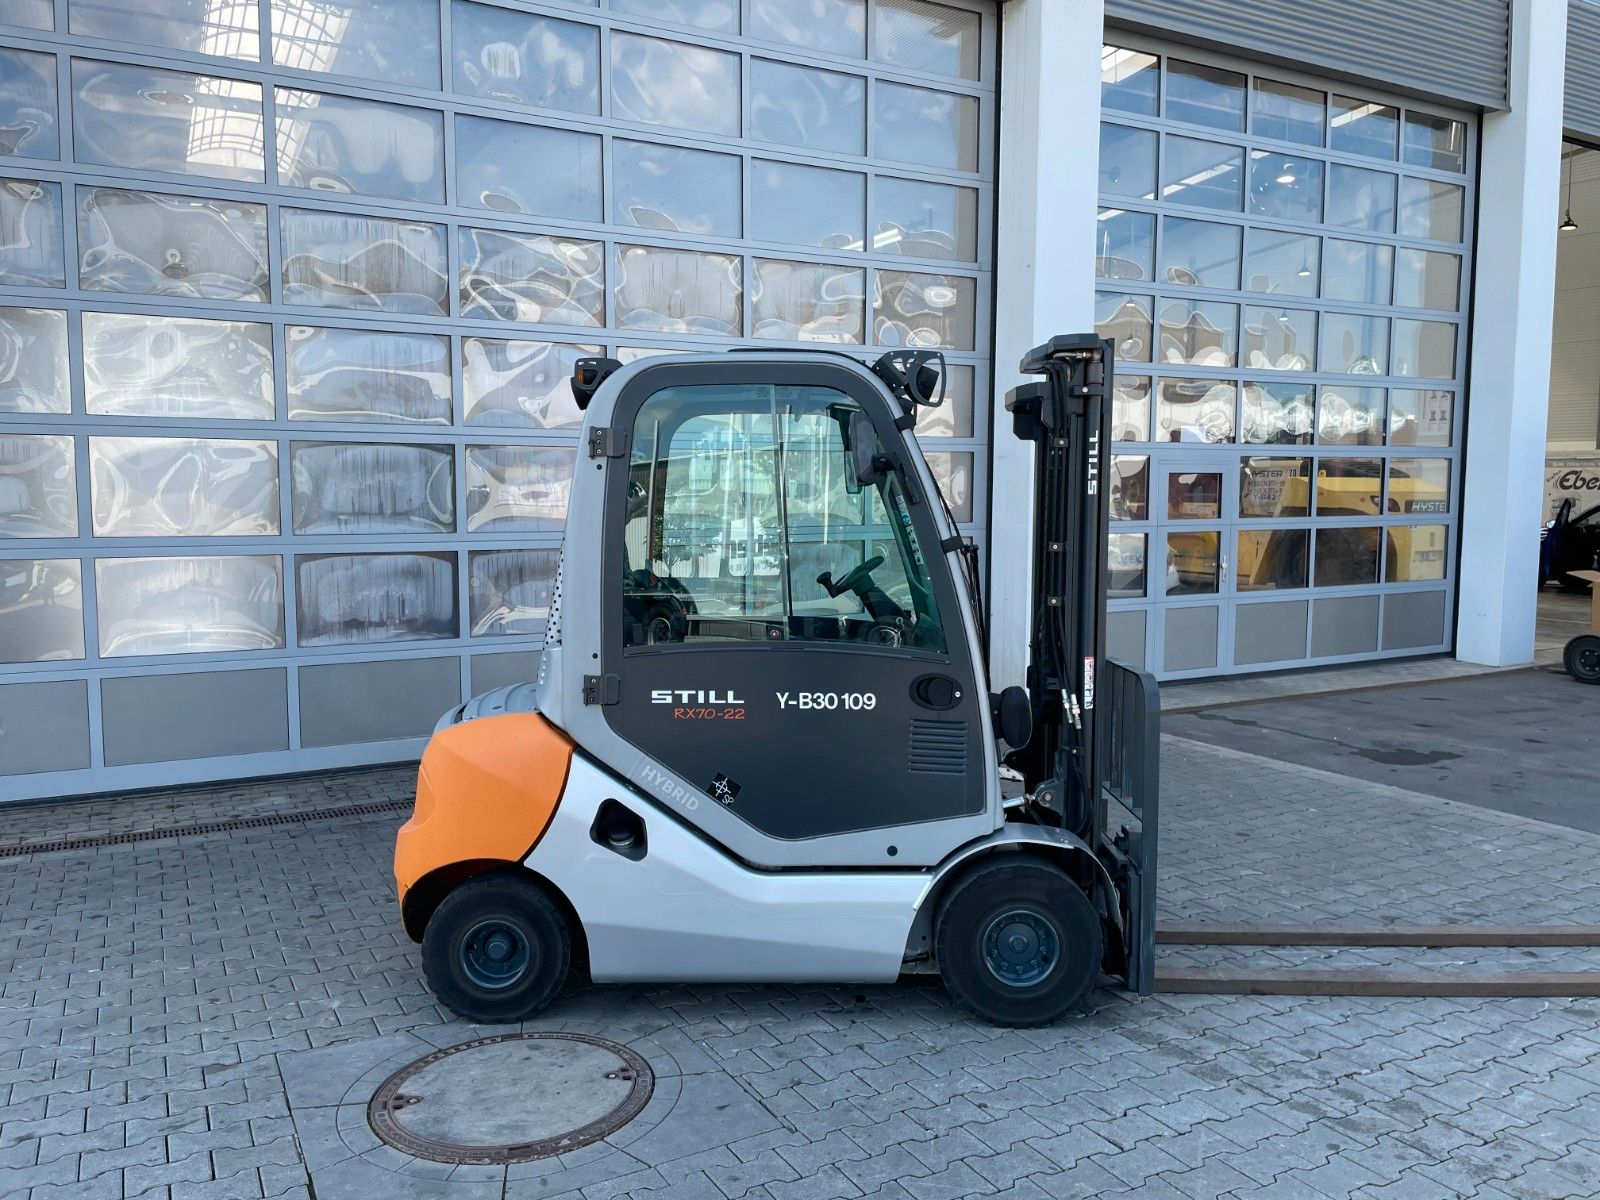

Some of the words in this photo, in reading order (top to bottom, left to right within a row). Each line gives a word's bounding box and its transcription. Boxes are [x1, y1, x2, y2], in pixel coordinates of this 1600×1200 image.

[1087, 430, 1098, 495] STILL
[651, 690, 745, 704] STILL
[674, 708, 745, 719] RX70-22
[641, 765, 699, 811] HYBRID
